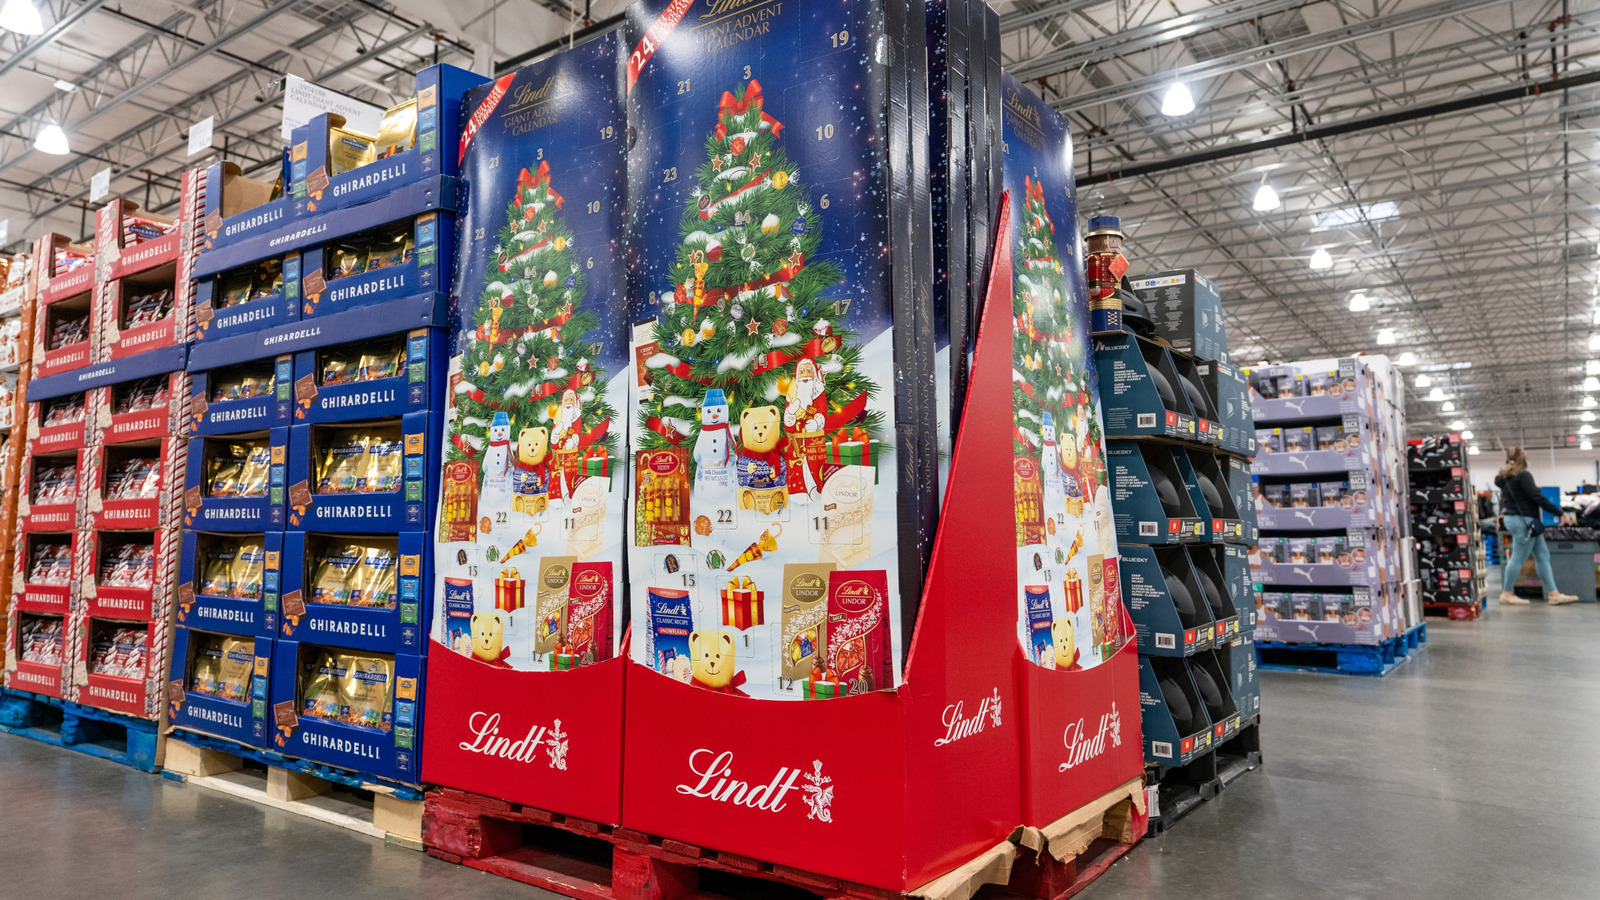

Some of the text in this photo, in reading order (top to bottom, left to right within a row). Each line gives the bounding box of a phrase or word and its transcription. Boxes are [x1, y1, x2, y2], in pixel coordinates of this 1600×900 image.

[696, 3, 783, 44] GIANT ADVENT
[707, 22, 770, 52] CALENDAR
[831, 30, 849, 48] 19
[631, 36, 654, 70] 24
[743, 65, 752, 79] 3
[508, 76, 554, 109] Lindt
[678, 79, 691, 95] 21
[290, 94, 326, 111] CALENDAR
[291, 88, 360, 116] LINDT GIANT ADVENT
[1006, 88, 1032, 120] Lindt
[504, 112, 532, 128] GIANT
[512, 114, 558, 136] CALENDAR
[462, 119, 477, 148] 24
[600, 126, 613, 140] 19
[816, 124, 834, 140] 10
[537, 148, 543, 160] 3
[334, 163, 406, 196] GHIRARDELLI
[664, 167, 677, 183] 23
[587, 201, 600, 214] 10
[820, 194, 830, 209] 6
[226, 208, 283, 236] GHIRARDELLI
[735, 209, 750, 225] 24
[475, 228, 485, 240] 23
[587, 257, 593, 269] 6
[330, 275, 405, 301] GHIRARDELLI
[649, 292, 656, 304] 8
[718, 299, 725, 312] 9
[833, 299, 851, 315] 17
[217, 306, 275, 329] GHIRARDELLI
[752, 354, 768, 369] 14
[321, 390, 395, 409] GHIRARDELLI
[211, 406, 266, 422] GHIRARDELLI
[205, 509, 260, 519] GHIRARDELLI
[316, 506, 392, 518] GHIRARDELLI
[777, 502, 783, 514] 7
[496, 512, 506, 523] 22
[564, 518, 575, 530] 11
[717, 510, 732, 524] 22
[814, 517, 829, 531] 11
[1057, 513, 1064, 524] 22
[1094, 520, 1099, 530] 11
[468, 566, 478, 577] 15
[580, 574, 595, 583] Lindt
[1044, 570, 1052, 582] 15
[682, 574, 695, 587] 15
[795, 578, 814, 587] Lindt
[448, 590, 465, 600] Lindt
[842, 586, 862, 595] Lindt
[656, 602, 680, 614] Lindt
[1030, 598, 1045, 610] Lindt
[198, 606, 254, 622] GHIRARDELLI
[509, 616, 513, 626] 1
[310, 618, 386, 638] GHIRARDELLI
[1076, 616, 1079, 627] 1
[742, 634, 748, 647] 1
[532, 651, 543, 662] 12
[1092, 646, 1098, 655] 12
[581, 652, 594, 664] 20
[777, 677, 793, 691] 12
[850, 679, 868, 694] 20
[188, 705, 242, 728] GHIRARDELLI
[934, 698, 990, 747] Lindt
[460, 711, 547, 764] Lindt
[1058, 714, 1110, 772] Lindt
[303, 732, 380, 759] GHIRARDELLI
[675, 748, 802, 812] Lindt
